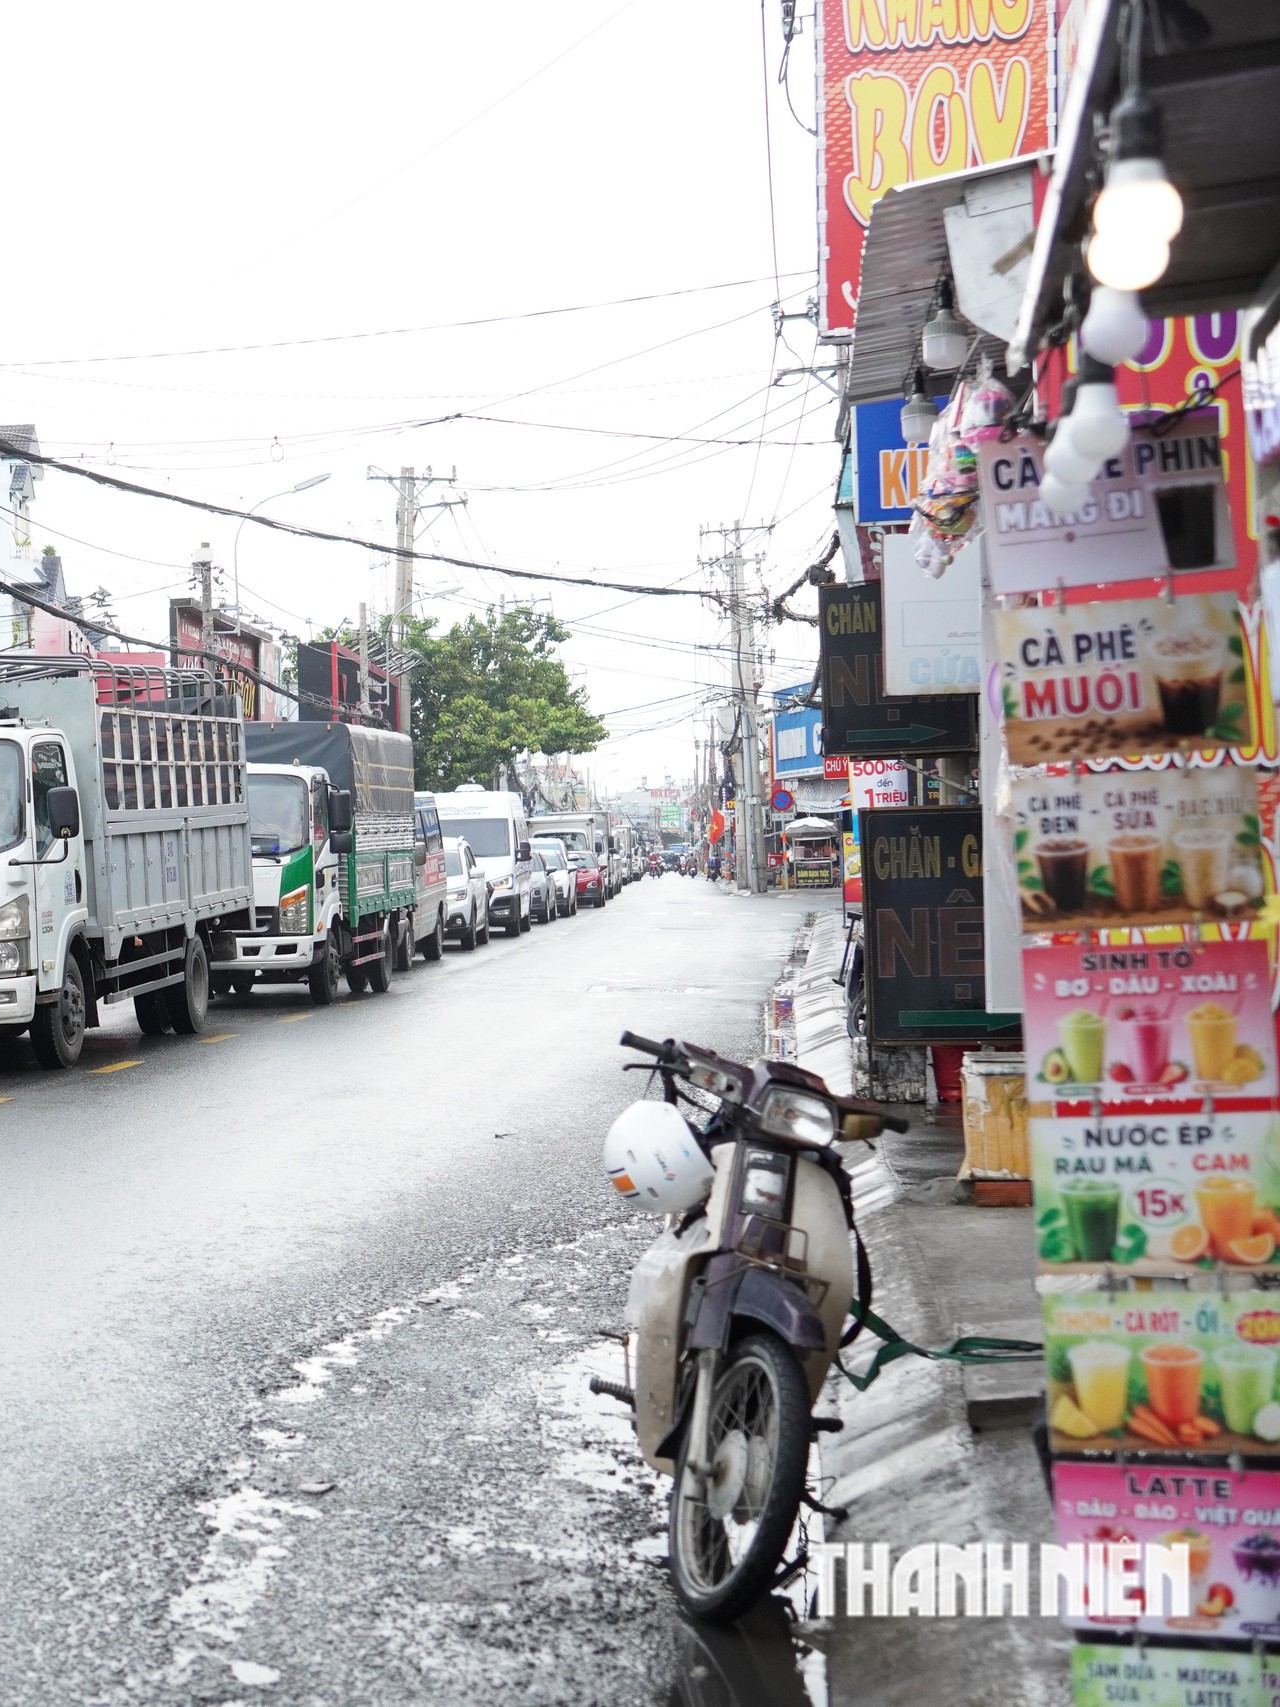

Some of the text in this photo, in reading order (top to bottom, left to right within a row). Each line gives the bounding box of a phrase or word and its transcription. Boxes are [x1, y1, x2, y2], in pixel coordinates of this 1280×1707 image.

[1134, 434, 1220, 476] PHIN
[1022, 622, 1136, 667] CÀ PHÊ
[1021, 664, 1144, 720] MUỐI
[877, 778, 893, 788] đến
[1083, 951, 1150, 971] SINH
[1084, 1123, 1169, 1149] NƯỚC
[1054, 1155, 1107, 1176] RAU
[1191, 1152, 1251, 1172] CAM
[1127, 1475, 1231, 1499] LATTE
